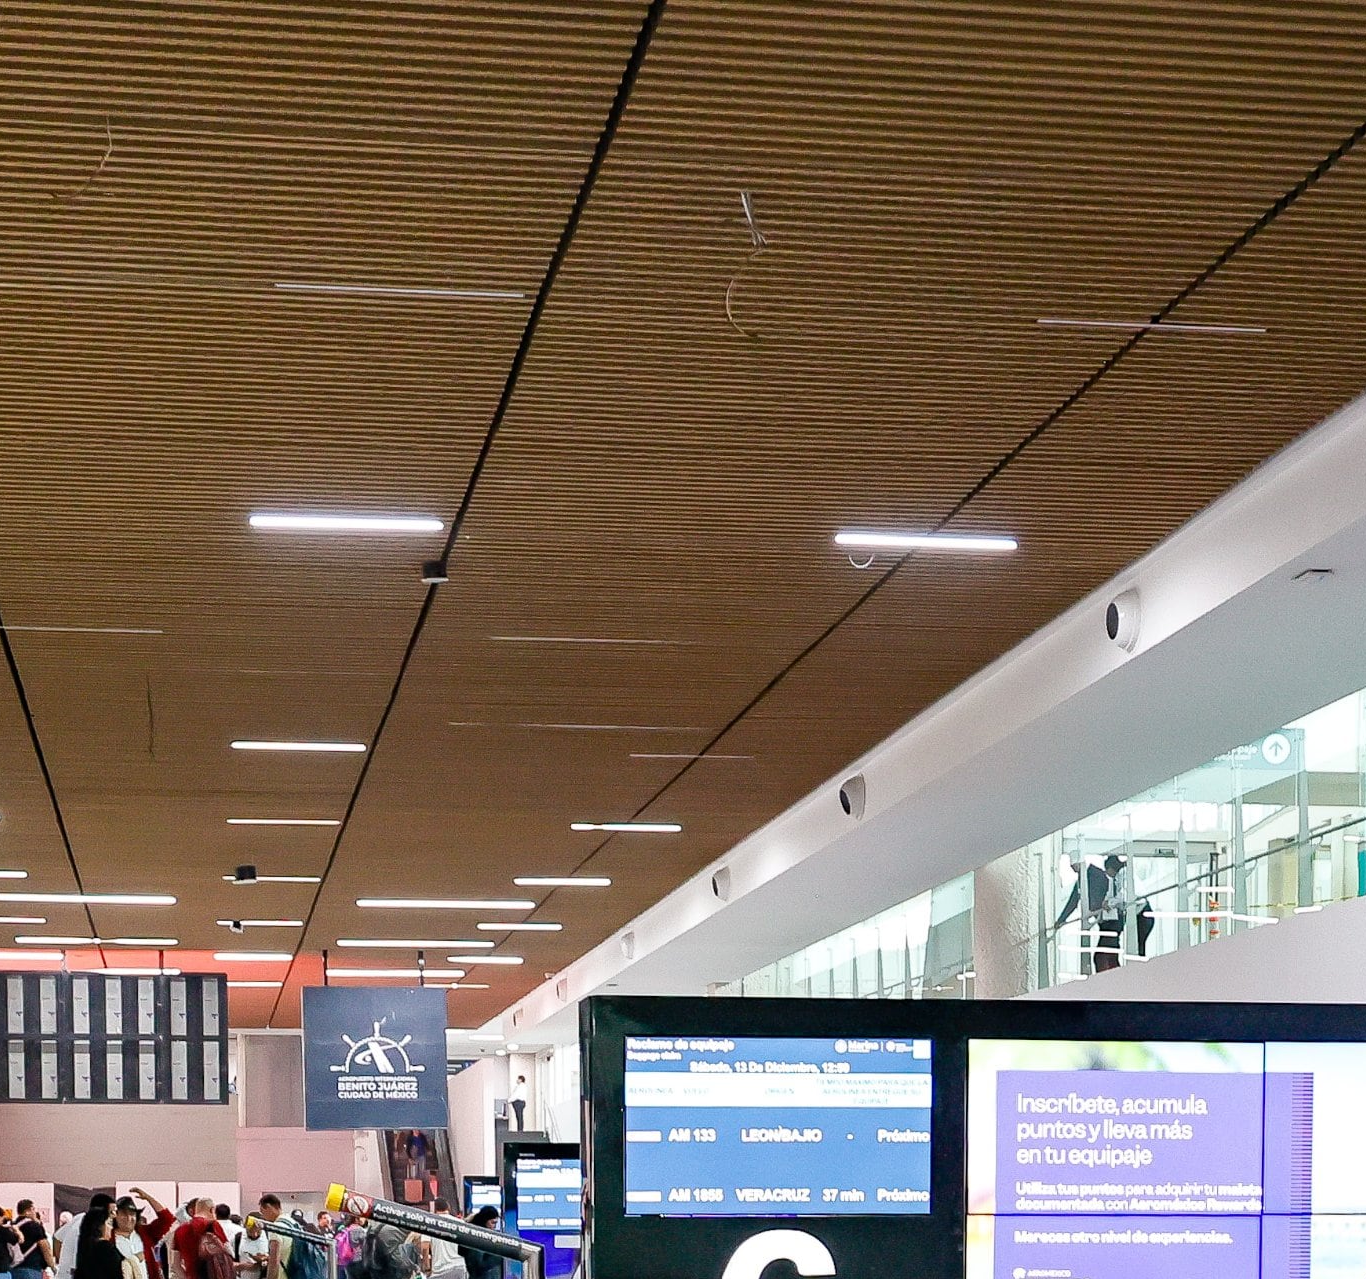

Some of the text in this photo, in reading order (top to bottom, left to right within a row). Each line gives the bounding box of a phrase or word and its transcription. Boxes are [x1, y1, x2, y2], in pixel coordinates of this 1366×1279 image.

[734, 1062, 748, 1073] 13
[748, 1062, 764, 1073] De
[338, 1080, 418, 1091] BENITO JUÁREZ
[338, 1090, 418, 1099] CIUDAD DE MÉXICO
[1016, 1092, 1209, 1116] Inscríbete, acumula
[668, 1127, 691, 1143] AM
[692, 1127, 717, 1143] 133
[876, 1127, 930, 1143] Próximo
[1016, 1118, 1194, 1143] puntos y lleva más
[1016, 1143, 1153, 1168] en tu equipaje
[668, 1187, 691, 1202] AM
[735, 1187, 810, 1202] VERACRUZ
[822, 1187, 838, 1202] 37
[840, 1187, 865, 1202] min
[876, 1187, 930, 1202] Próximo
[1079, 1183, 1124, 1198] puntos
[1125, 1184, 1154, 1198] para
[1155, 1182, 1204, 1198] adquirir
[1204, 1183, 1217, 1196] tu
[1217, 1183, 1262, 1196] maleta
[1015, 1197, 1105, 1211] documentada
[1105, 1200, 1129, 1211] con
[375, 1203, 519, 1247] Activar solo en caso de emergencia
[1071, 1231, 1100, 1244] otro
[1100, 1229, 1132, 1244] nivel
[1132, 1229, 1148, 1244] de
